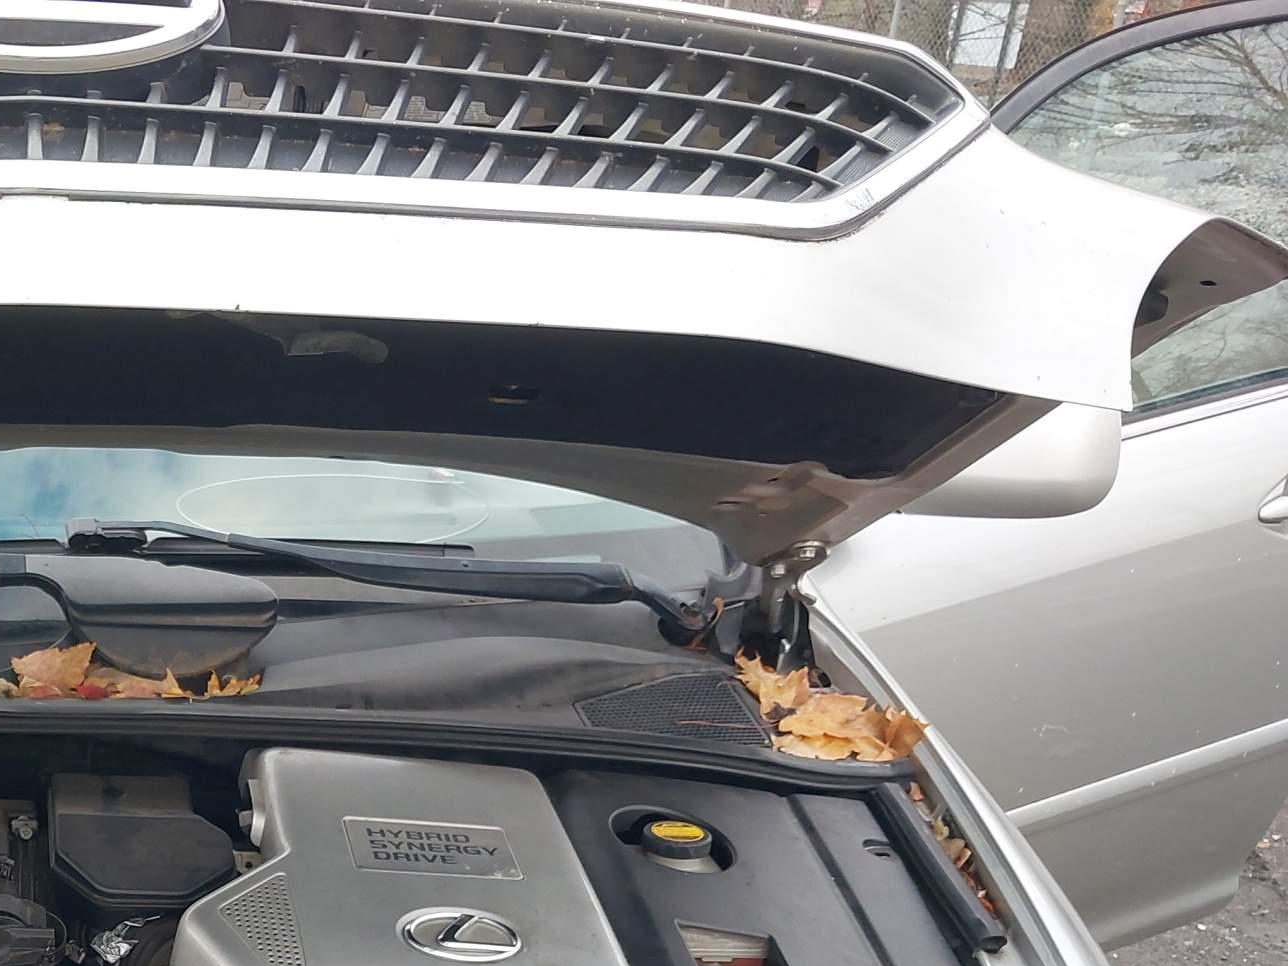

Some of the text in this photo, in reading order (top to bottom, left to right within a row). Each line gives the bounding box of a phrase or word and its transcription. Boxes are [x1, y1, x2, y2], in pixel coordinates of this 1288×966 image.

[366, 828, 470, 843] HYBRID
[369, 840, 498, 856] SYNERGY
[373, 851, 457, 865] DRIVE
